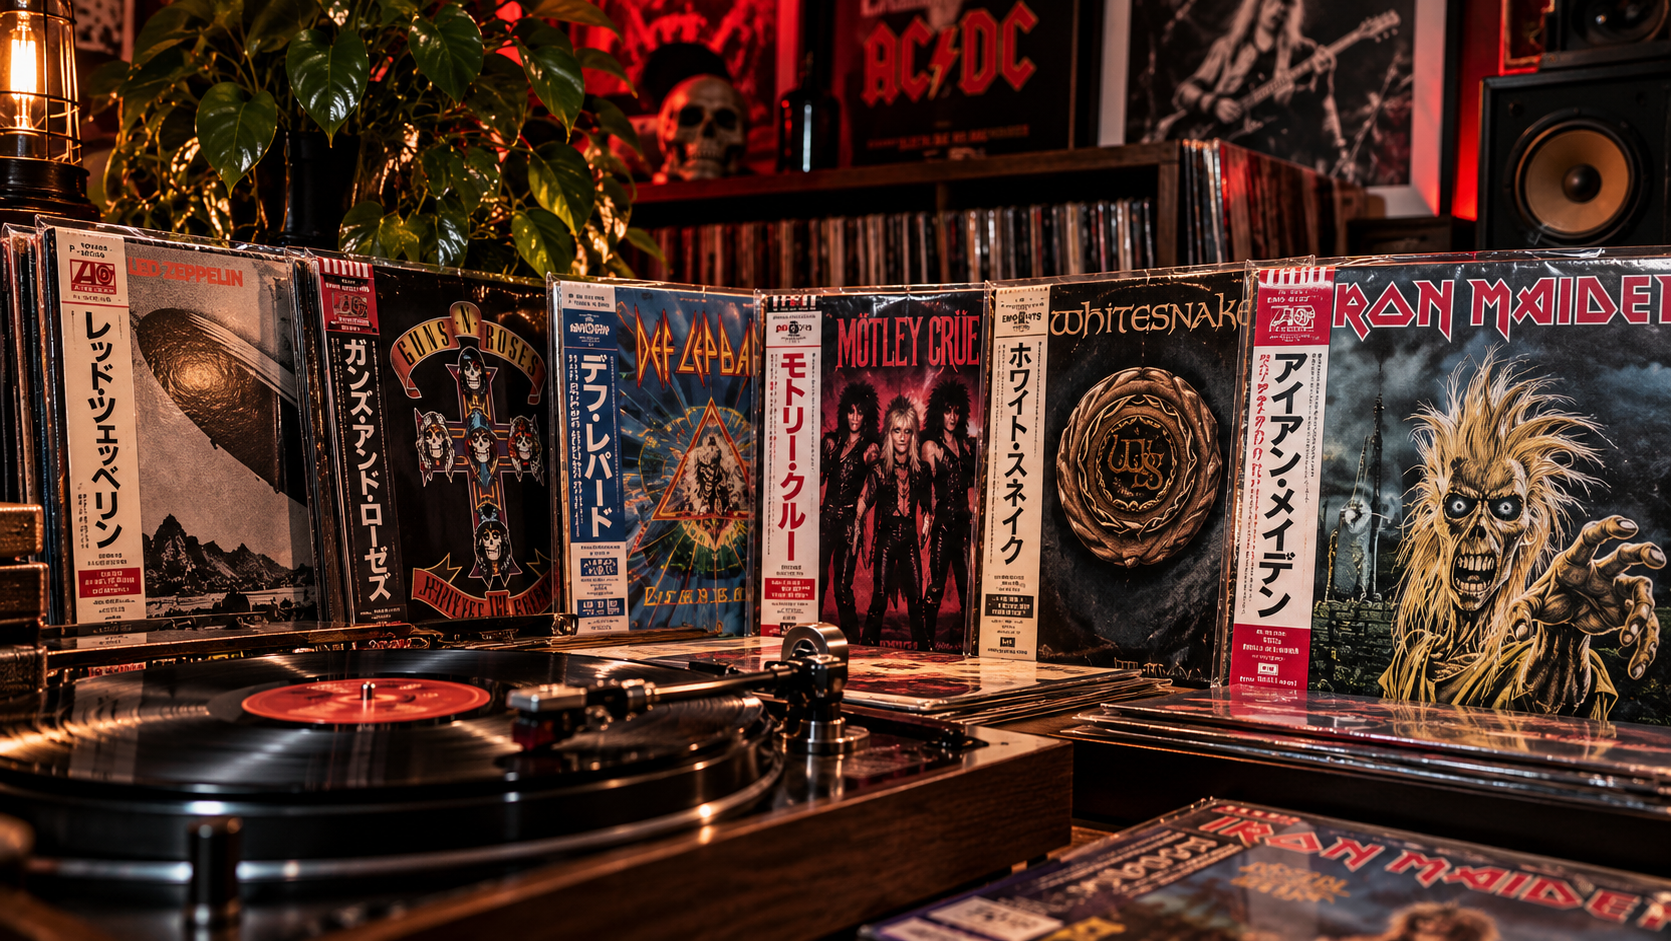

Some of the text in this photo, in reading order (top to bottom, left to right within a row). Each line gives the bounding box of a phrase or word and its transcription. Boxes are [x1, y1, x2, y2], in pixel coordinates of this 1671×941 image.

[128, 256, 161, 277] LED
[162, 261, 243, 287] ZEPPELIN
[396, 320, 450, 367] GUNS
[485, 324, 540, 377] ROSES
[634, 303, 675, 390] DEF
[834, 312, 923, 371] MÖTLEY
[928, 309, 980, 373] CRÜE
[580, 354, 613, 538] デフ・レパード
[777, 352, 807, 561] モトリー・クルー
[1000, 342, 1032, 566] ホワイト・スネイク
[1257, 352, 1308, 619] アイアン・メイデン
[1198, 815, 1385, 873] IRON
